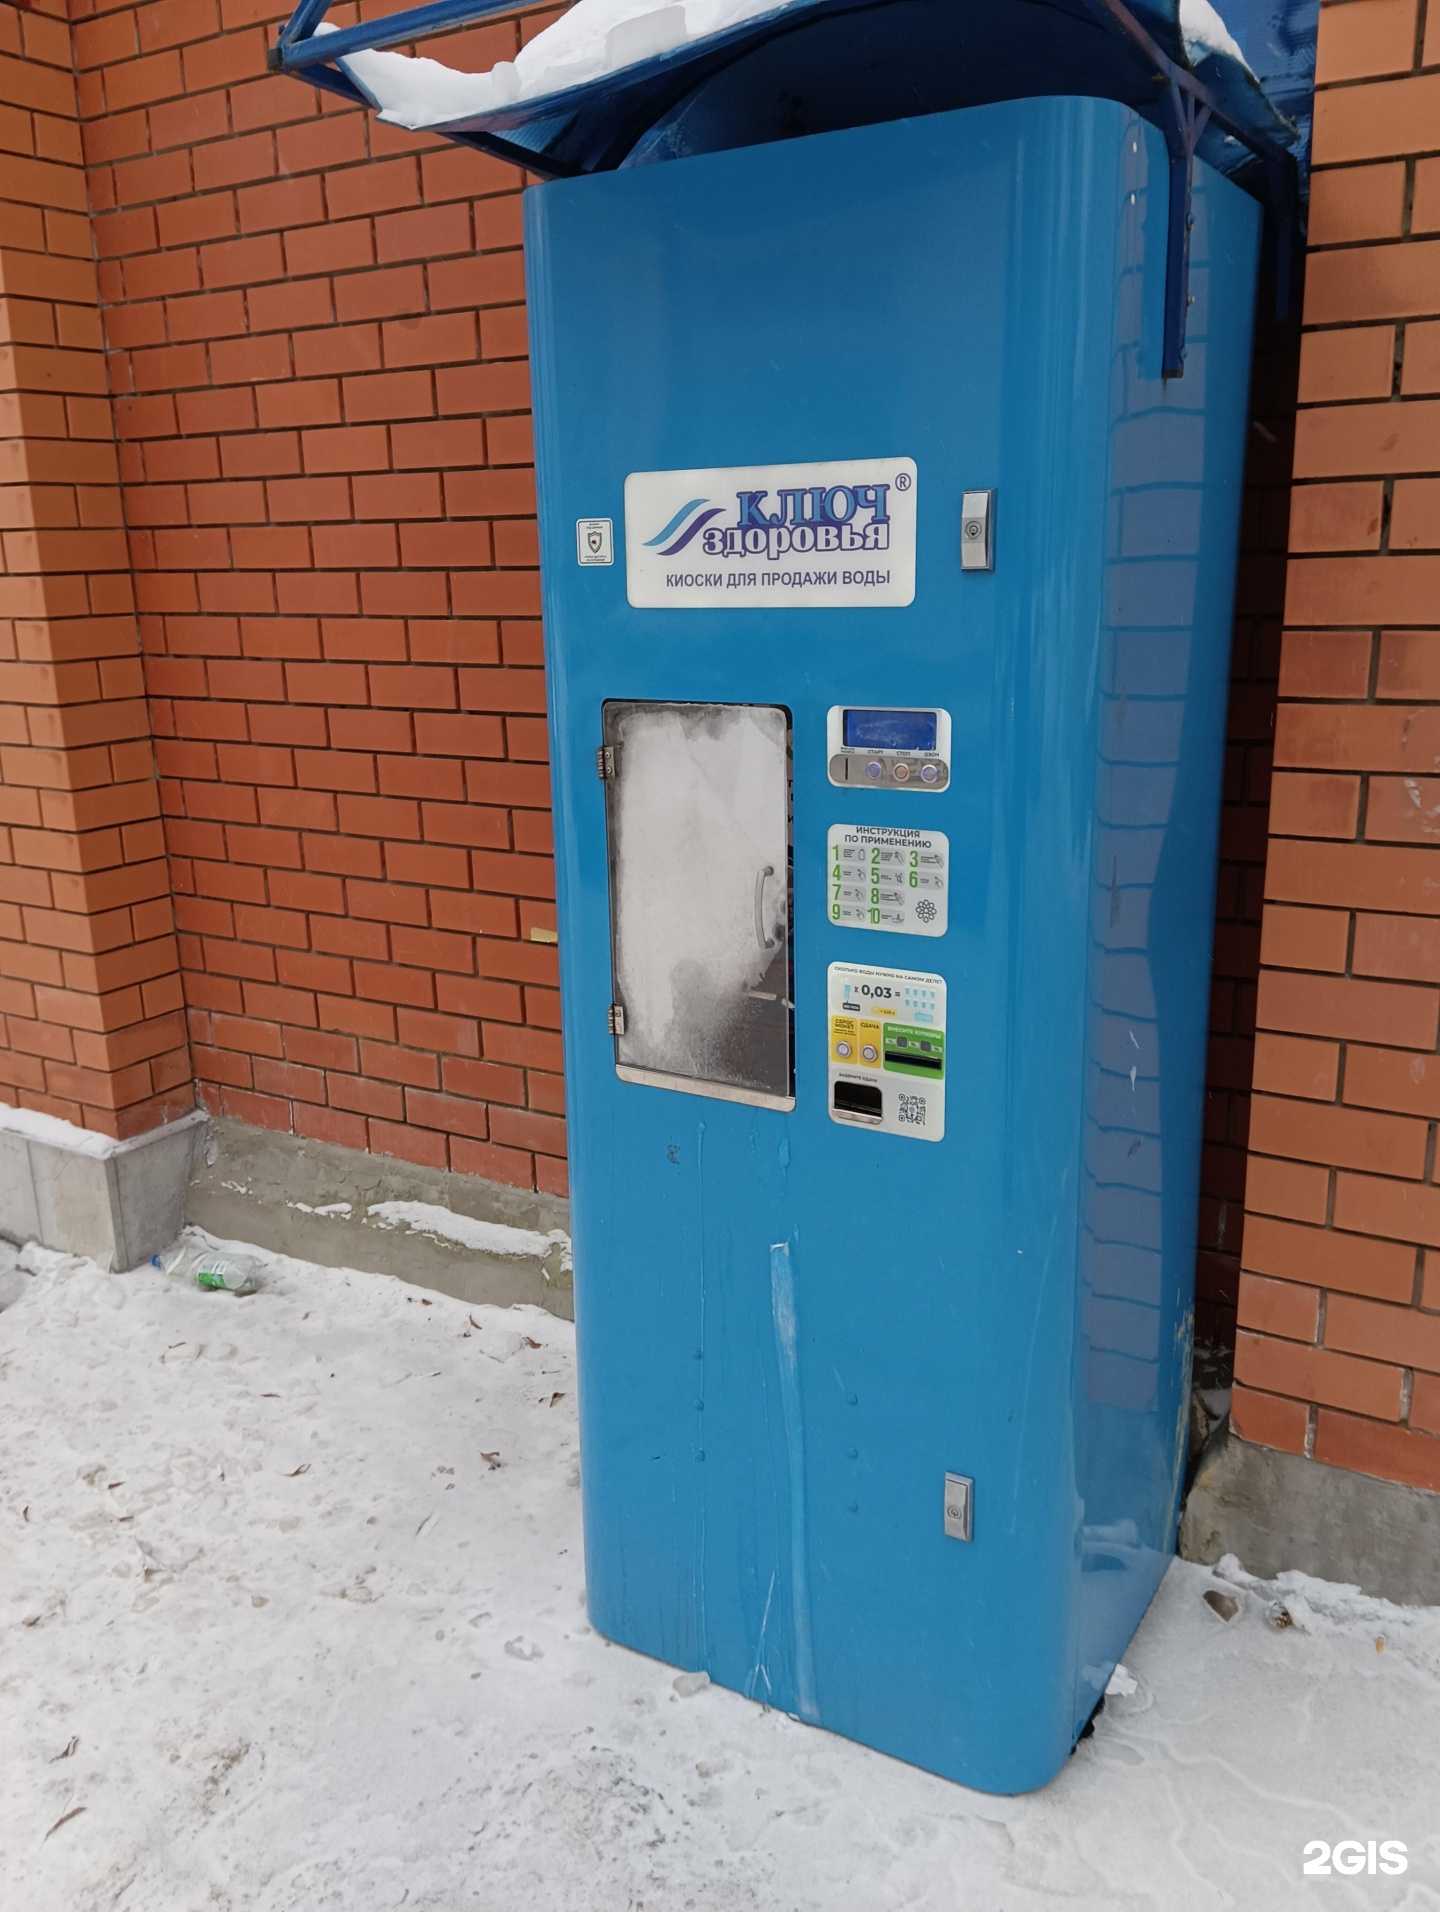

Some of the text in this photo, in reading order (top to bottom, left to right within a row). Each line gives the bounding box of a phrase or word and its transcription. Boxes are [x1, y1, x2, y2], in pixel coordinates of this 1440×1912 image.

[736, 484, 890, 526] КЛЮЧ
[666, 569, 890, 589] КИОСКИ ДЛЯ ПРОДАЖИ ВОДЫ
[856, 826, 920, 838] ИНСТРУКЦИЯ
[844, 834, 932, 848] ПО ПРИМЕНЕНИЮ
[832, 844, 840, 861] 1
[871, 847, 880, 864] 2
[909, 850, 918, 868] 3
[832, 864, 841, 880] 4
[871, 867, 880, 884] 5
[909, 871, 918, 888] 6
[832, 884, 841, 900] 7
[871, 888, 880, 904] 8
[832, 903, 841, 920] 9
[867, 907, 880, 924] 10
[861, 984, 892, 999] 0,03
